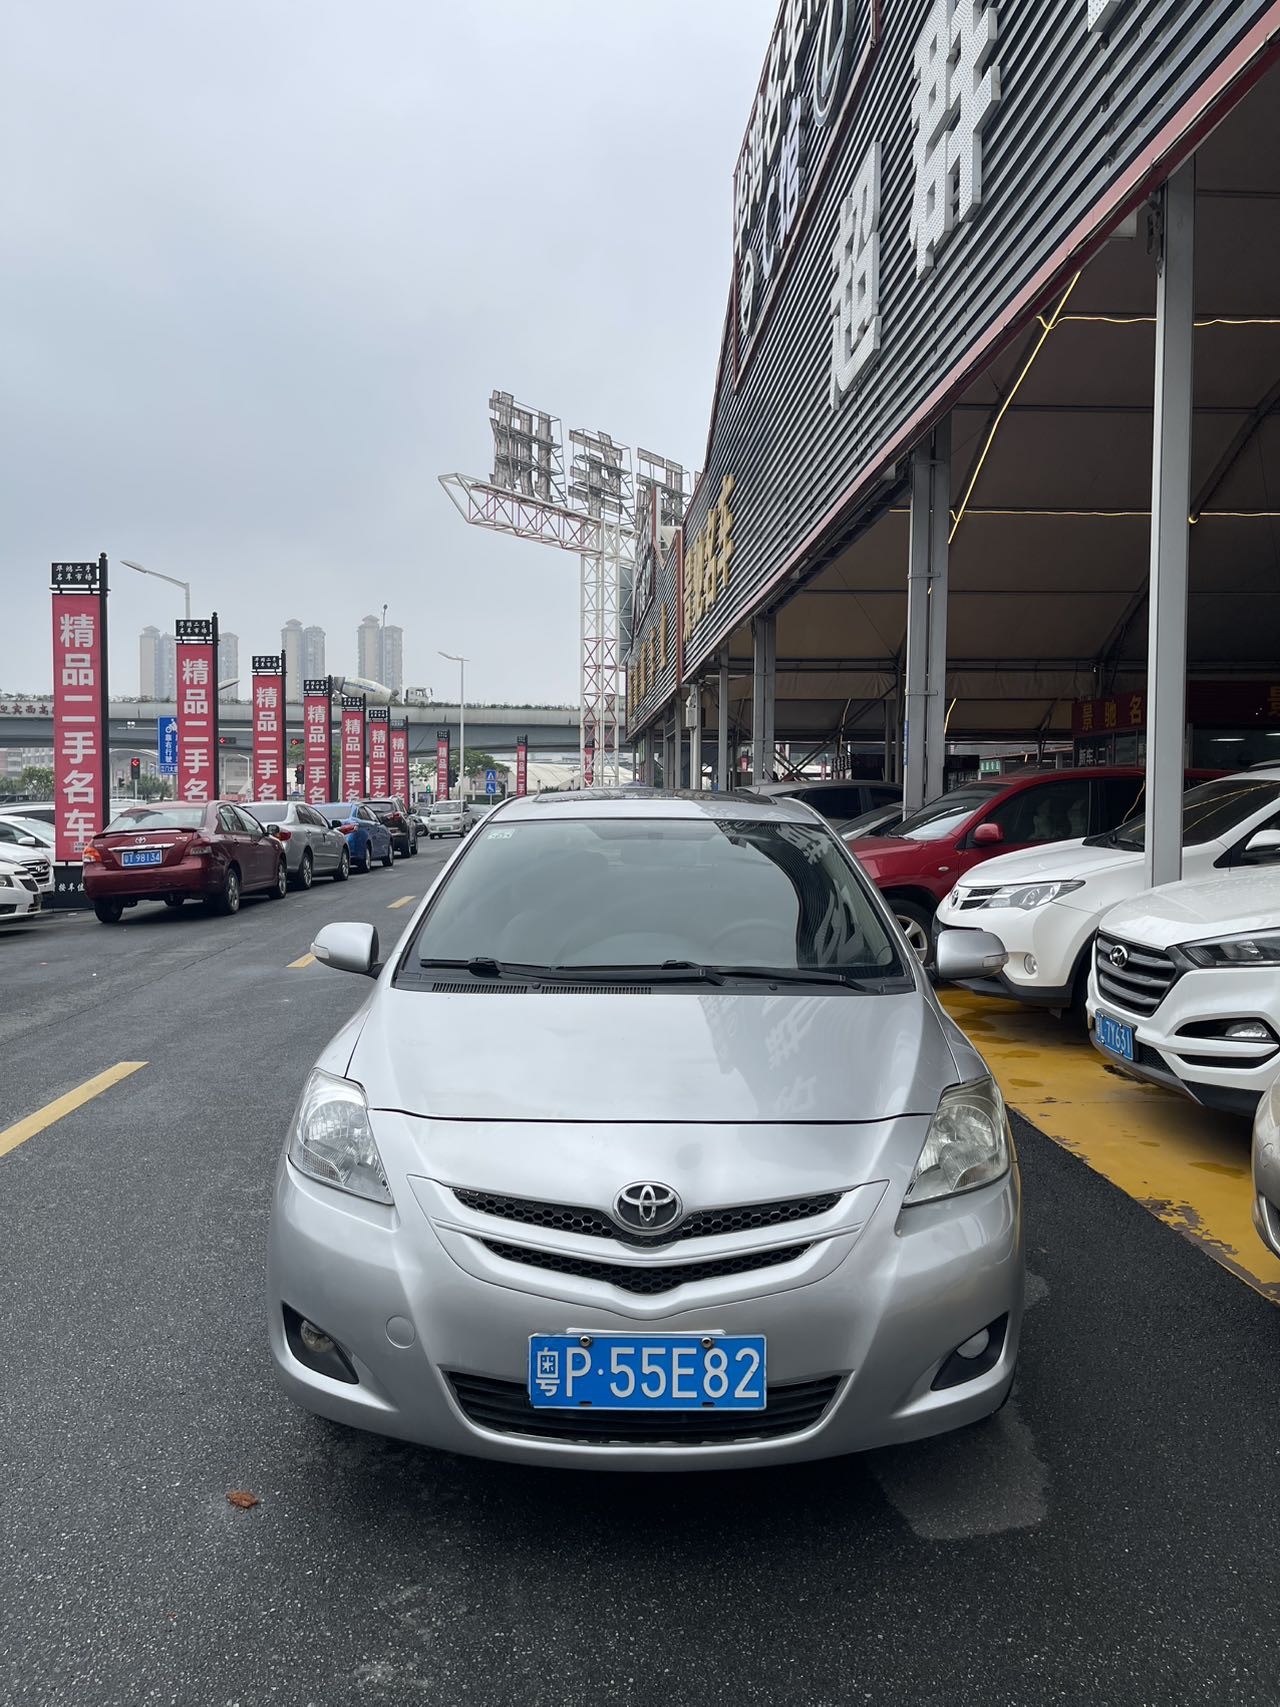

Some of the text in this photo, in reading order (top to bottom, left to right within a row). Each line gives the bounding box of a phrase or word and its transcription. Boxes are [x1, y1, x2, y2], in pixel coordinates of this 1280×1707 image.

[60, 613, 96, 844] 精品二手名车
[536, 1347, 760, 1398] 粤P·55E82
